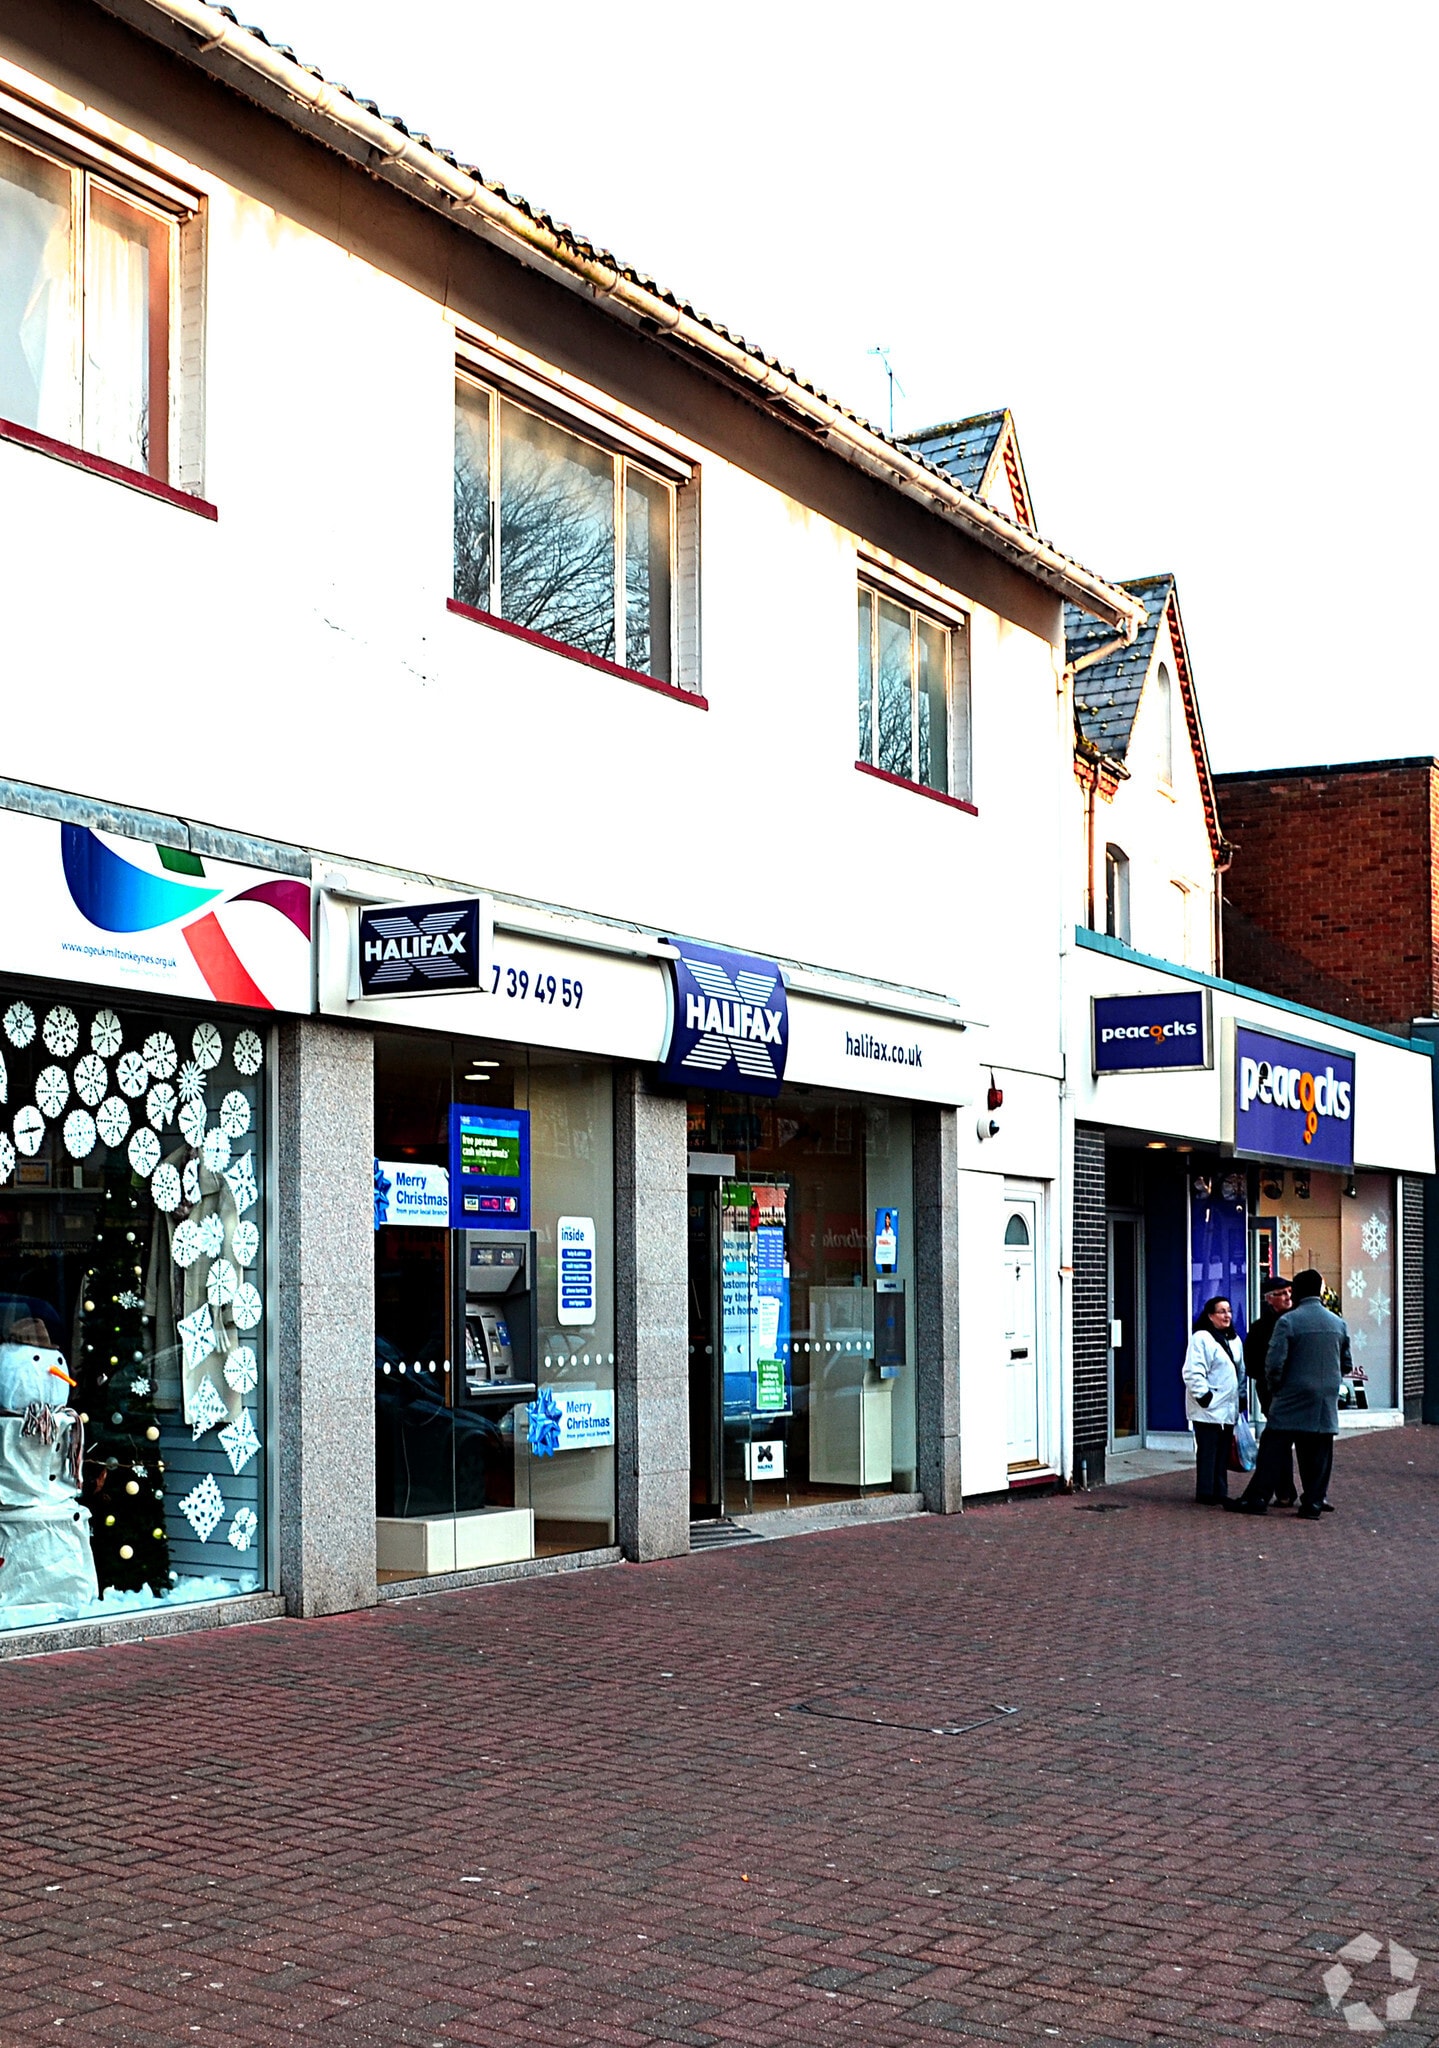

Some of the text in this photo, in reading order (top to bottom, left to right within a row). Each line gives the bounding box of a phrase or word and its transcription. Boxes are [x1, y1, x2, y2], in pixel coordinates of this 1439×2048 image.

[364, 932, 467, 962] HALIFAX
[507, 968, 529, 1000] 39
[534, 973, 557, 1005] 49
[562, 978, 583, 1010] 59
[686, 993, 783, 1045] HALIFAX
[1101, 1020, 1197, 1044] peacocks
[846, 1031, 923, 1068] halifax.co.uk
[1240, 1056, 1351, 1121] peacocks
[396, 1171, 427, 1190] Merry
[396, 1190, 448, 1206] Christmas
[561, 1227, 585, 1242] inside
[722, 1238, 735, 1250] his
[742, 1252, 758, 1264] help
[723, 1293, 732, 1304] uy
[737, 1305, 758, 1315] home
[567, 1401, 592, 1414] Merry
[567, 1417, 610, 1430] Christmas
